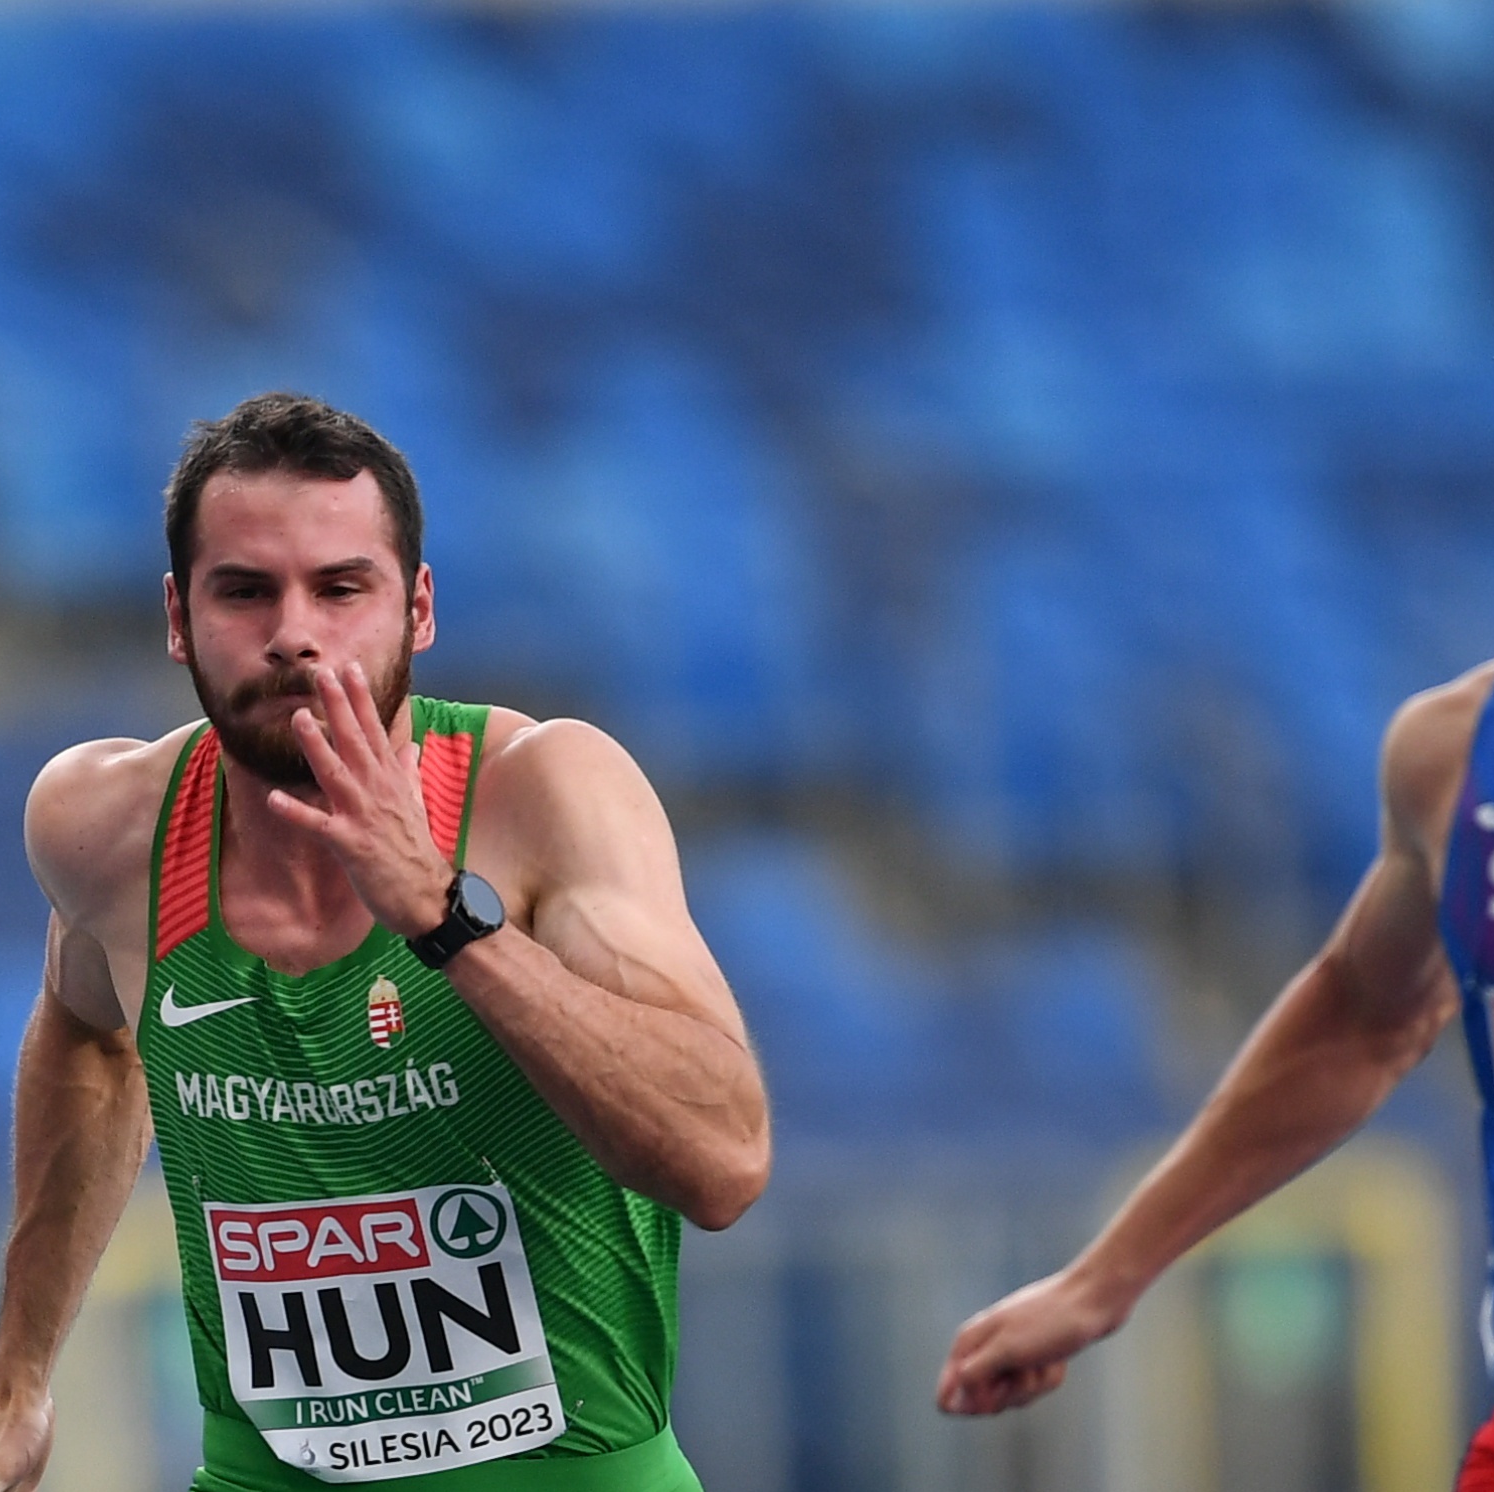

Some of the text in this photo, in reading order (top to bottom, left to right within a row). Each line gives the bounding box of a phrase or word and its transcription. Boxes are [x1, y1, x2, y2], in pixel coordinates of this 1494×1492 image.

[218, 1211, 420, 1271] SPAR
[238, 1262, 522, 1389] HUN
[295, 1401, 303, 1424] I
[310, 1397, 370, 1423] RUN
[329, 1403, 553, 1470] SILESIA 2023
